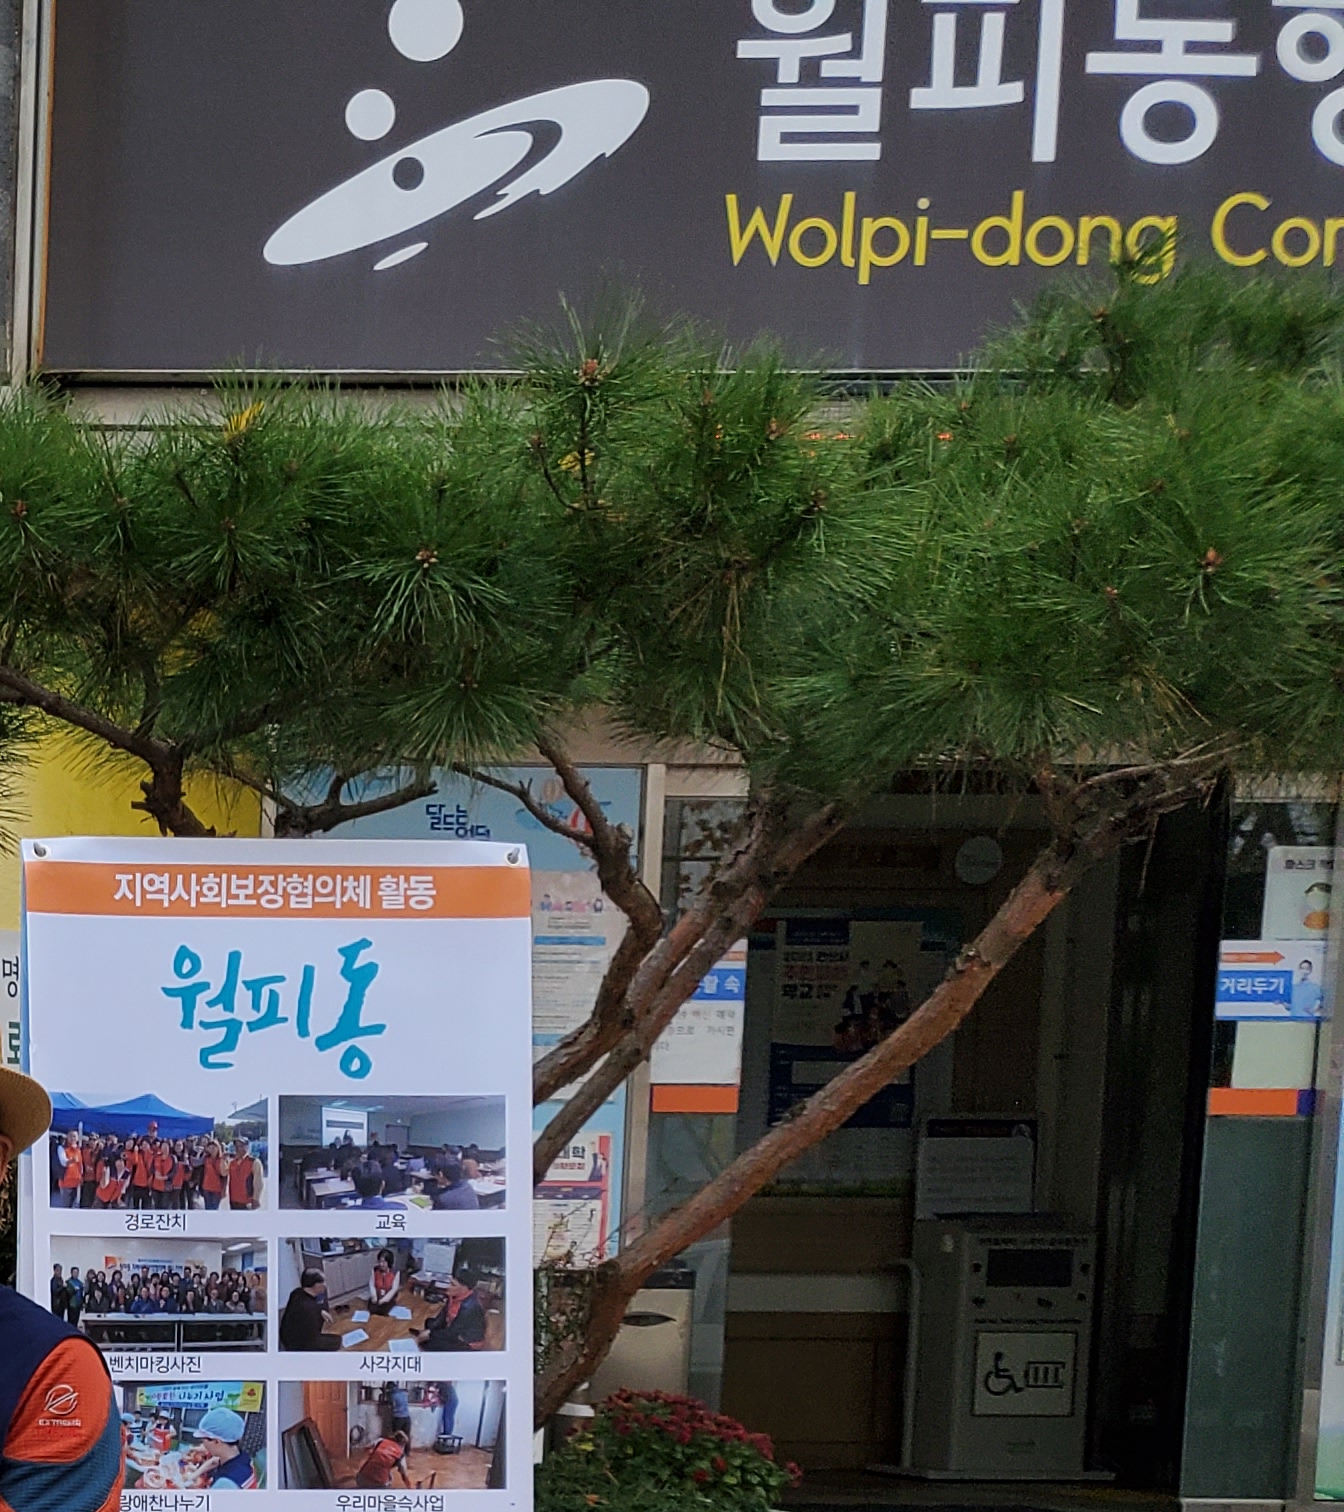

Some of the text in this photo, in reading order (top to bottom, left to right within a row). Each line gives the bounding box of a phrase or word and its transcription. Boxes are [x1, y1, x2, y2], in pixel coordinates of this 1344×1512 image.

[725, 190, 1179, 285] Wolpi-dong
[113, 872, 438, 911] 지역사회보장협의체 활동
[1220, 976, 1285, 995] 거리두기
[160, 936, 388, 1080] 월피동
[123, 1213, 187, 1234] 경로잔치
[374, 1213, 407, 1233] 교육
[109, 1354, 202, 1375] 벤치마킹사진
[358, 1354, 423, 1375] 사각지대
